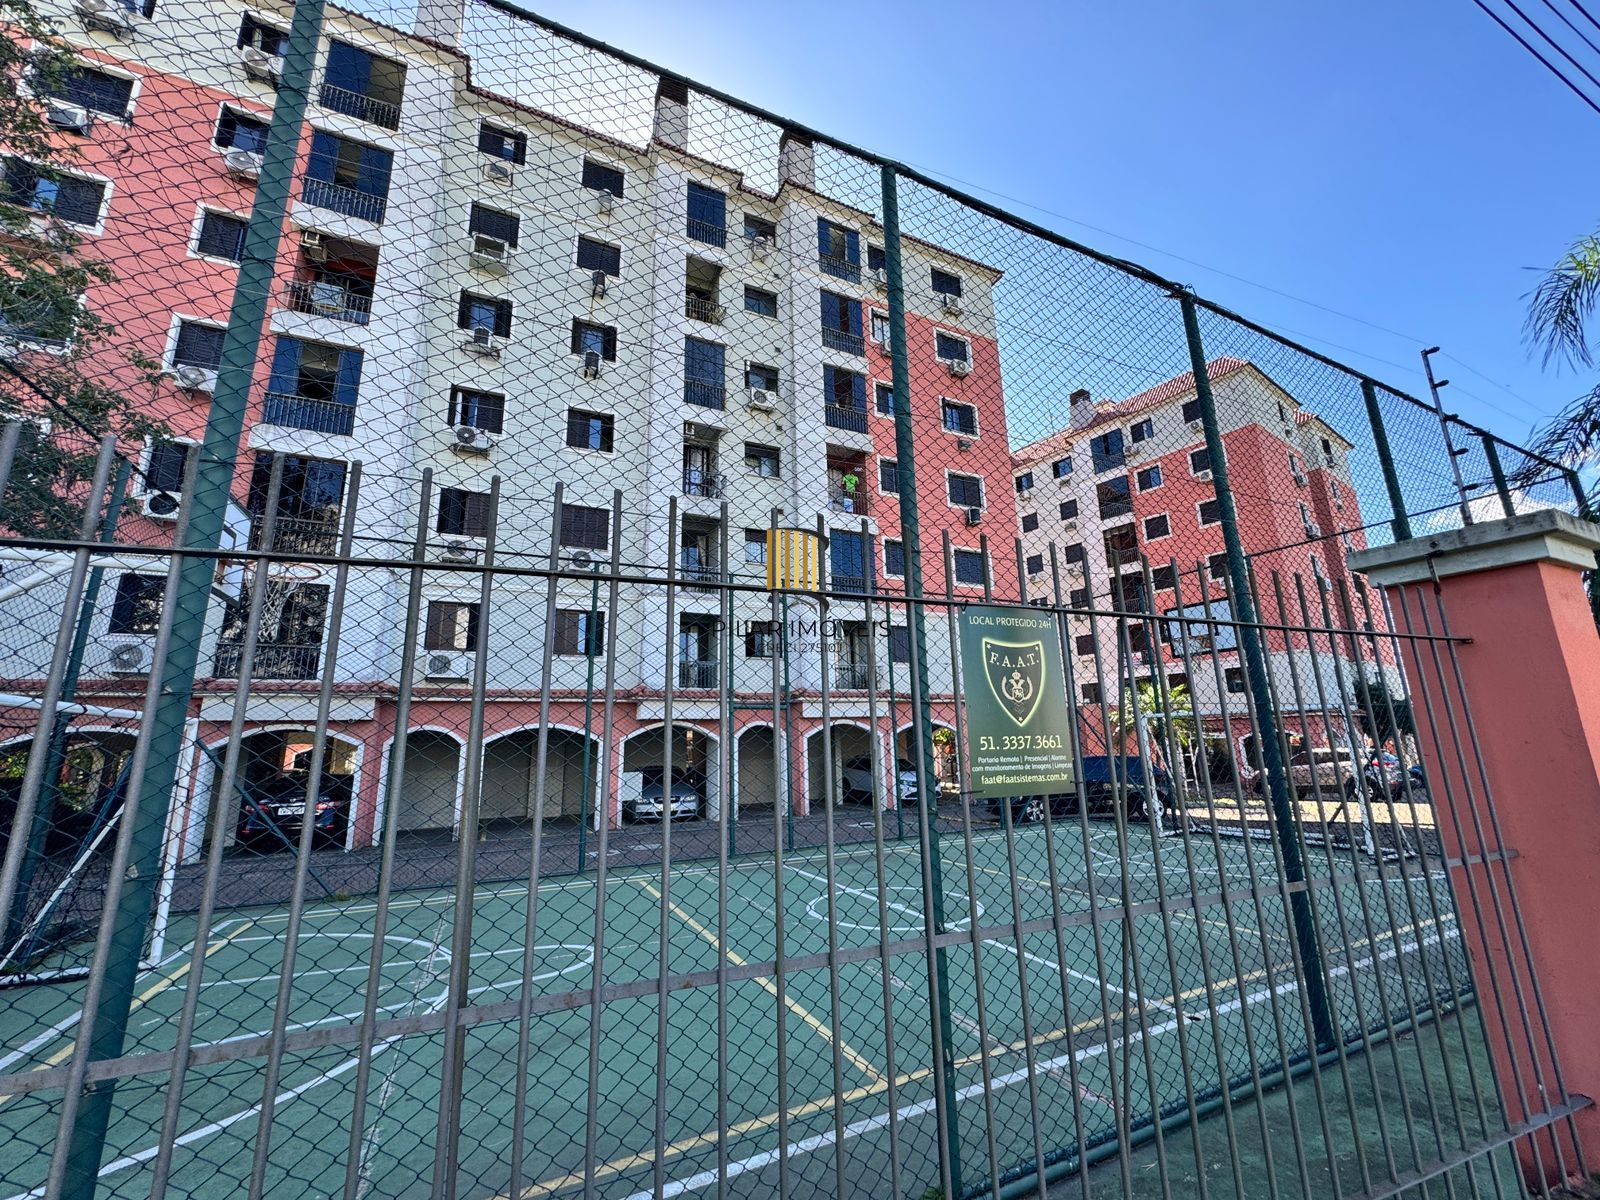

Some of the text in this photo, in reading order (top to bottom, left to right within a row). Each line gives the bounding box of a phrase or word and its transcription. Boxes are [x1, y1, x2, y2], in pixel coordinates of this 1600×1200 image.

[969, 616, 1052, 629] LOCAL PROTEGIDO 24H
[1002, 735, 1062, 750] 3337.3661
[1000, 755, 1019, 763] Remota
[1024, 754, 1048, 762] Presencial
[985, 763, 1024, 772] monitoramento
[981, 772, 1068, 785] faat@faatsistemas.com.br
